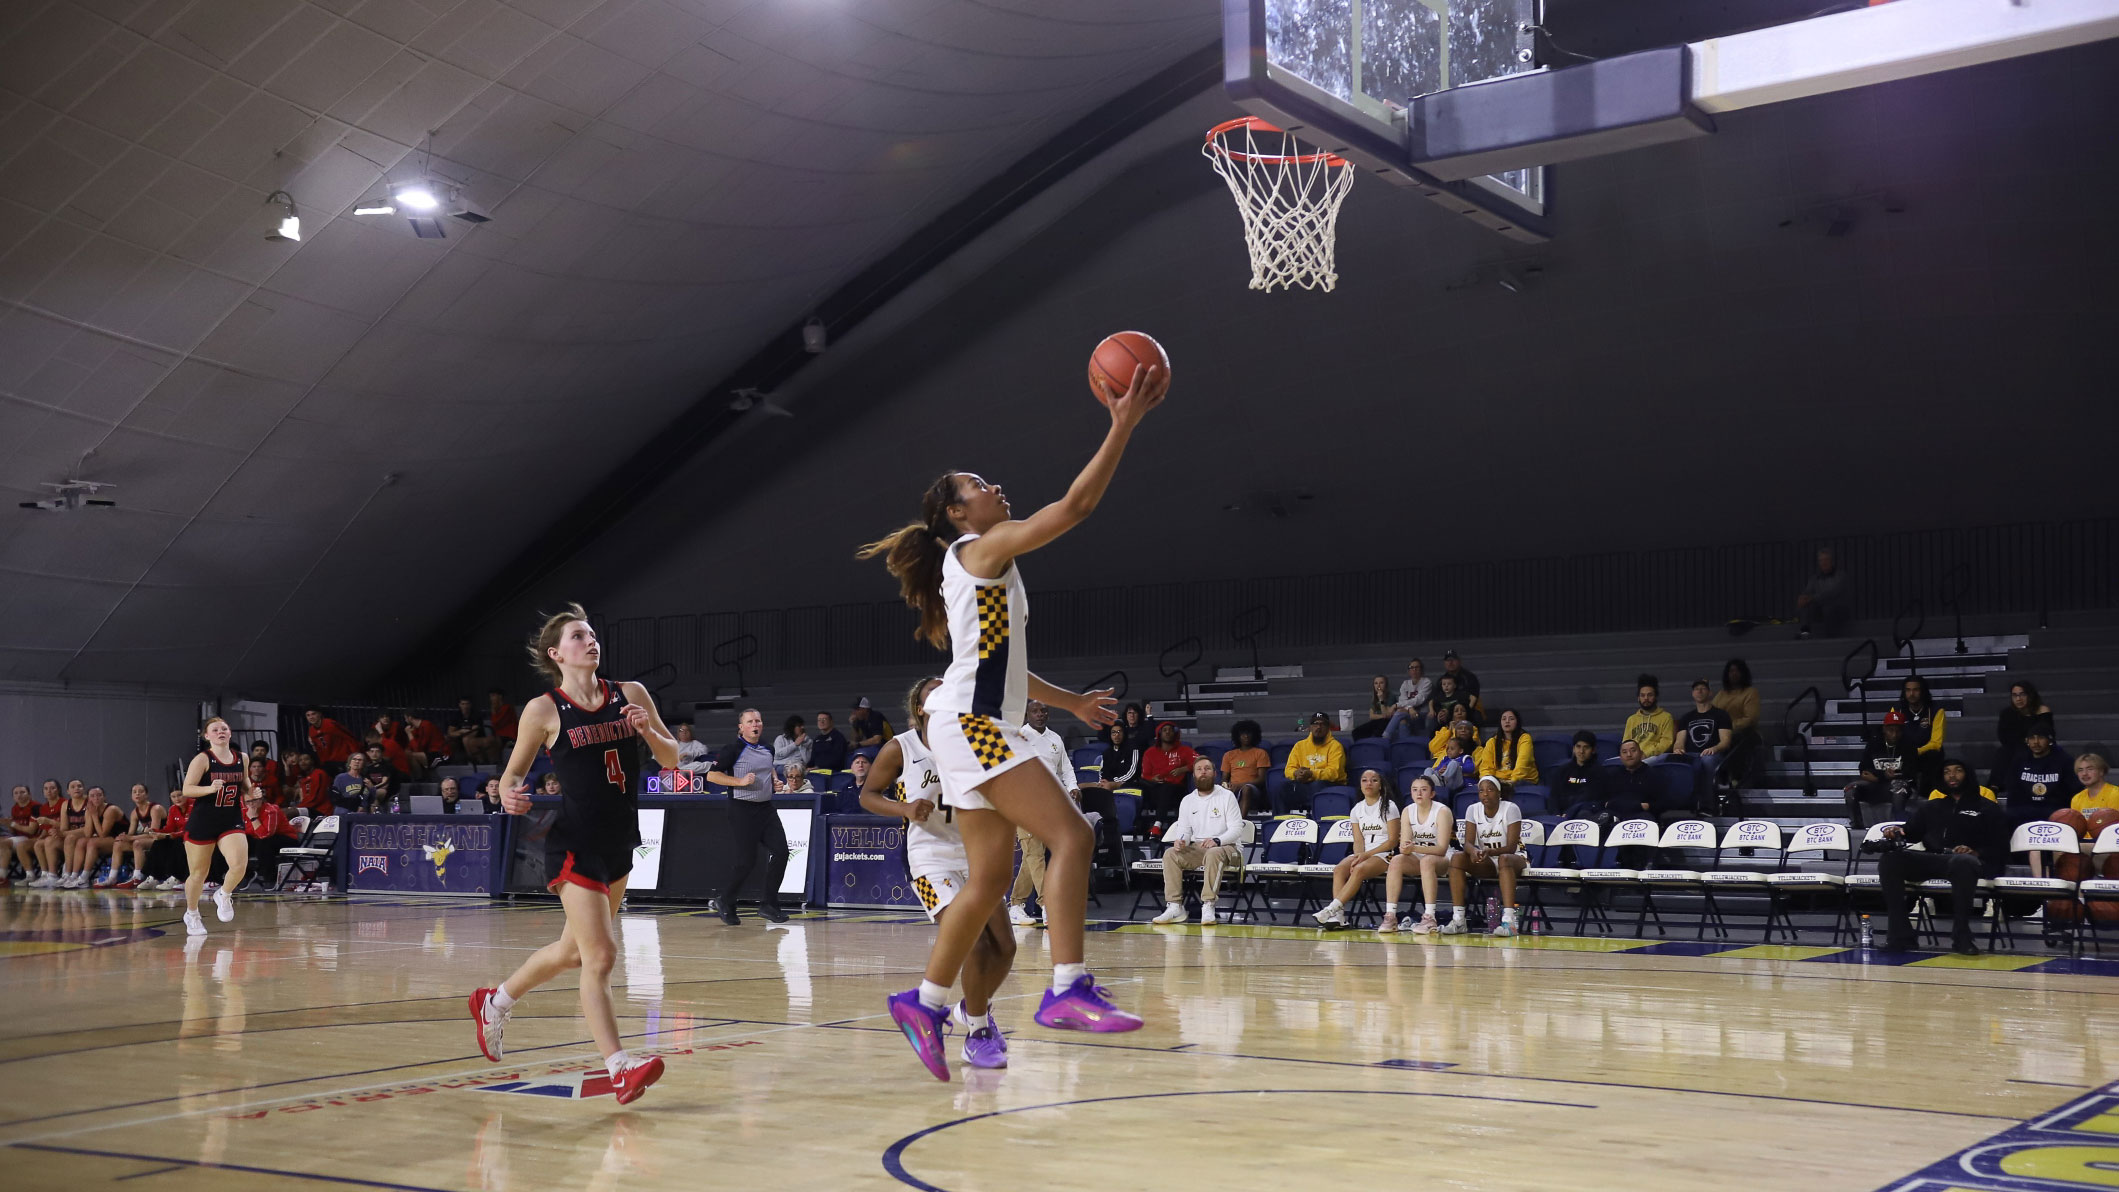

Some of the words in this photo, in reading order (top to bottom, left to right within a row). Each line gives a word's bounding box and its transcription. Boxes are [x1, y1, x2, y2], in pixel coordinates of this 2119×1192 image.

[605, 749, 626, 794] 4
[2021, 772, 2059, 783] GRACELAND
[215, 785, 237, 807] 12
[1362, 823, 1382, 832] Jackets
[2037, 826, 2053, 834] BTC
[351, 824, 491, 851] GRACELAND
[359, 855, 388, 874] NAIA
[834, 852, 885, 862] gujackets.com
